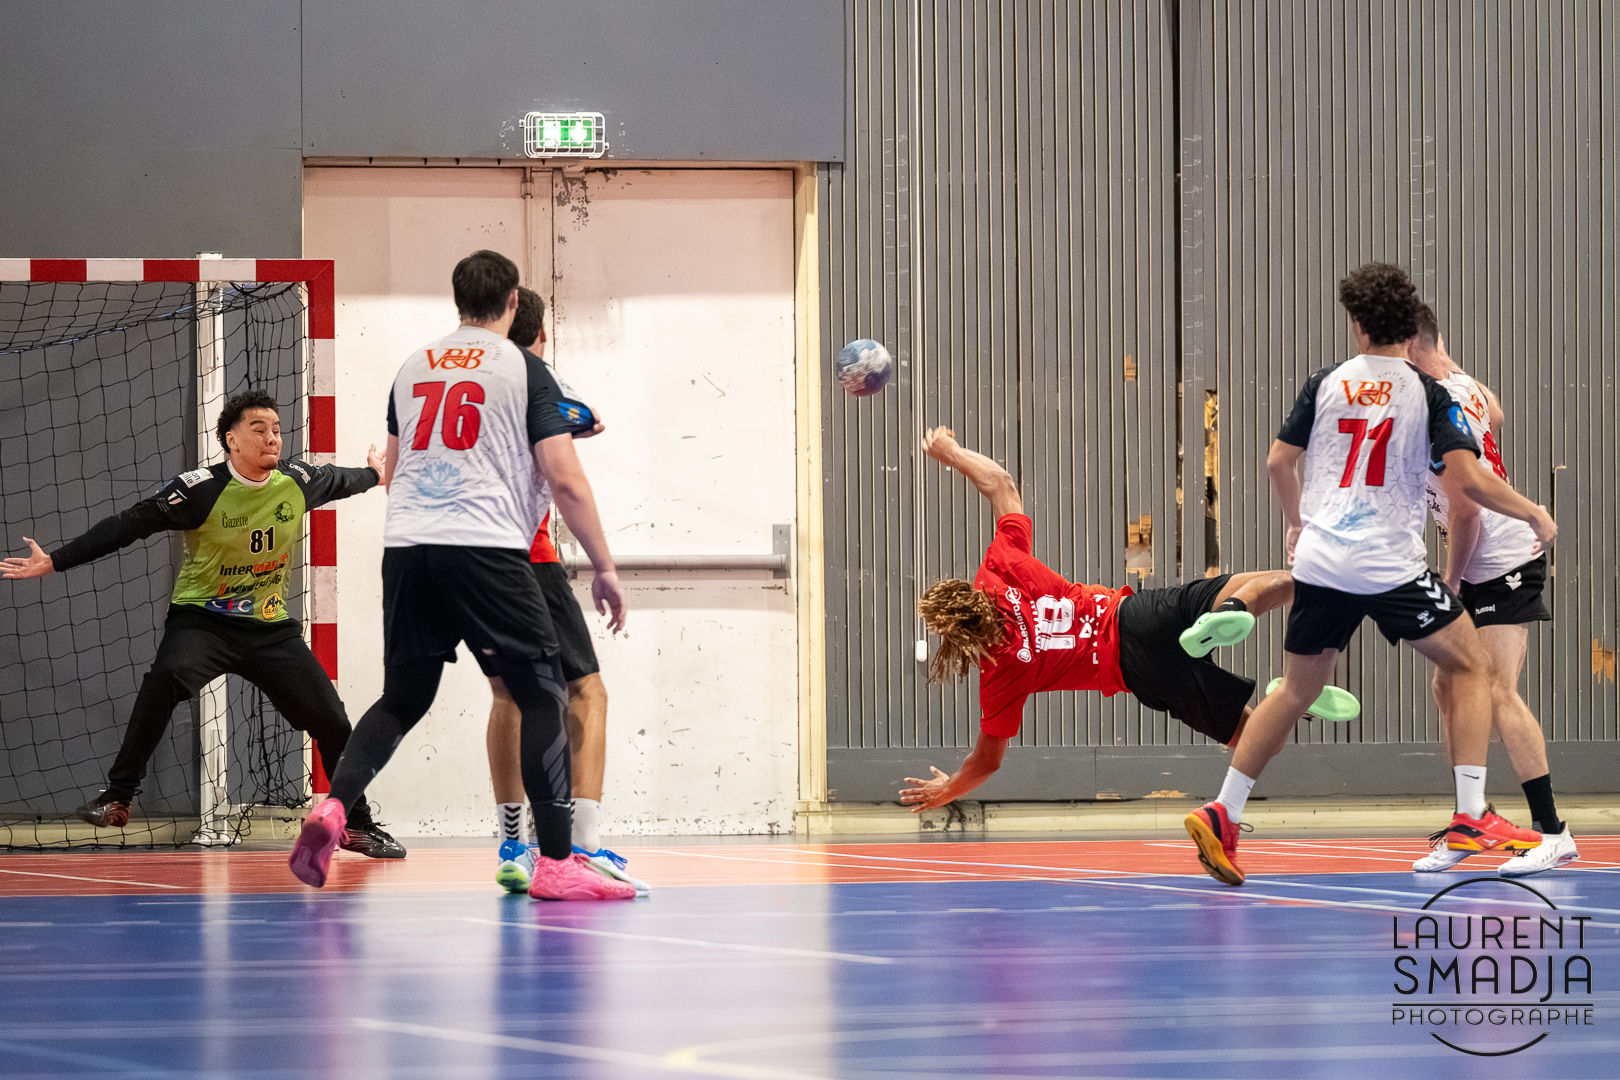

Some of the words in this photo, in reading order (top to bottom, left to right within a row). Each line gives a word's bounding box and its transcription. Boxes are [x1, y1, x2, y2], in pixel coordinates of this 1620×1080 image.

[425, 348, 486, 371] V&B
[1340, 380, 1394, 407] V&B
[411, 380, 486, 451] 76
[1338, 417, 1395, 488] 71
[222, 515, 249, 529] Gazette
[249, 525, 275, 555] 81
[1035, 594, 1075, 651] 18
